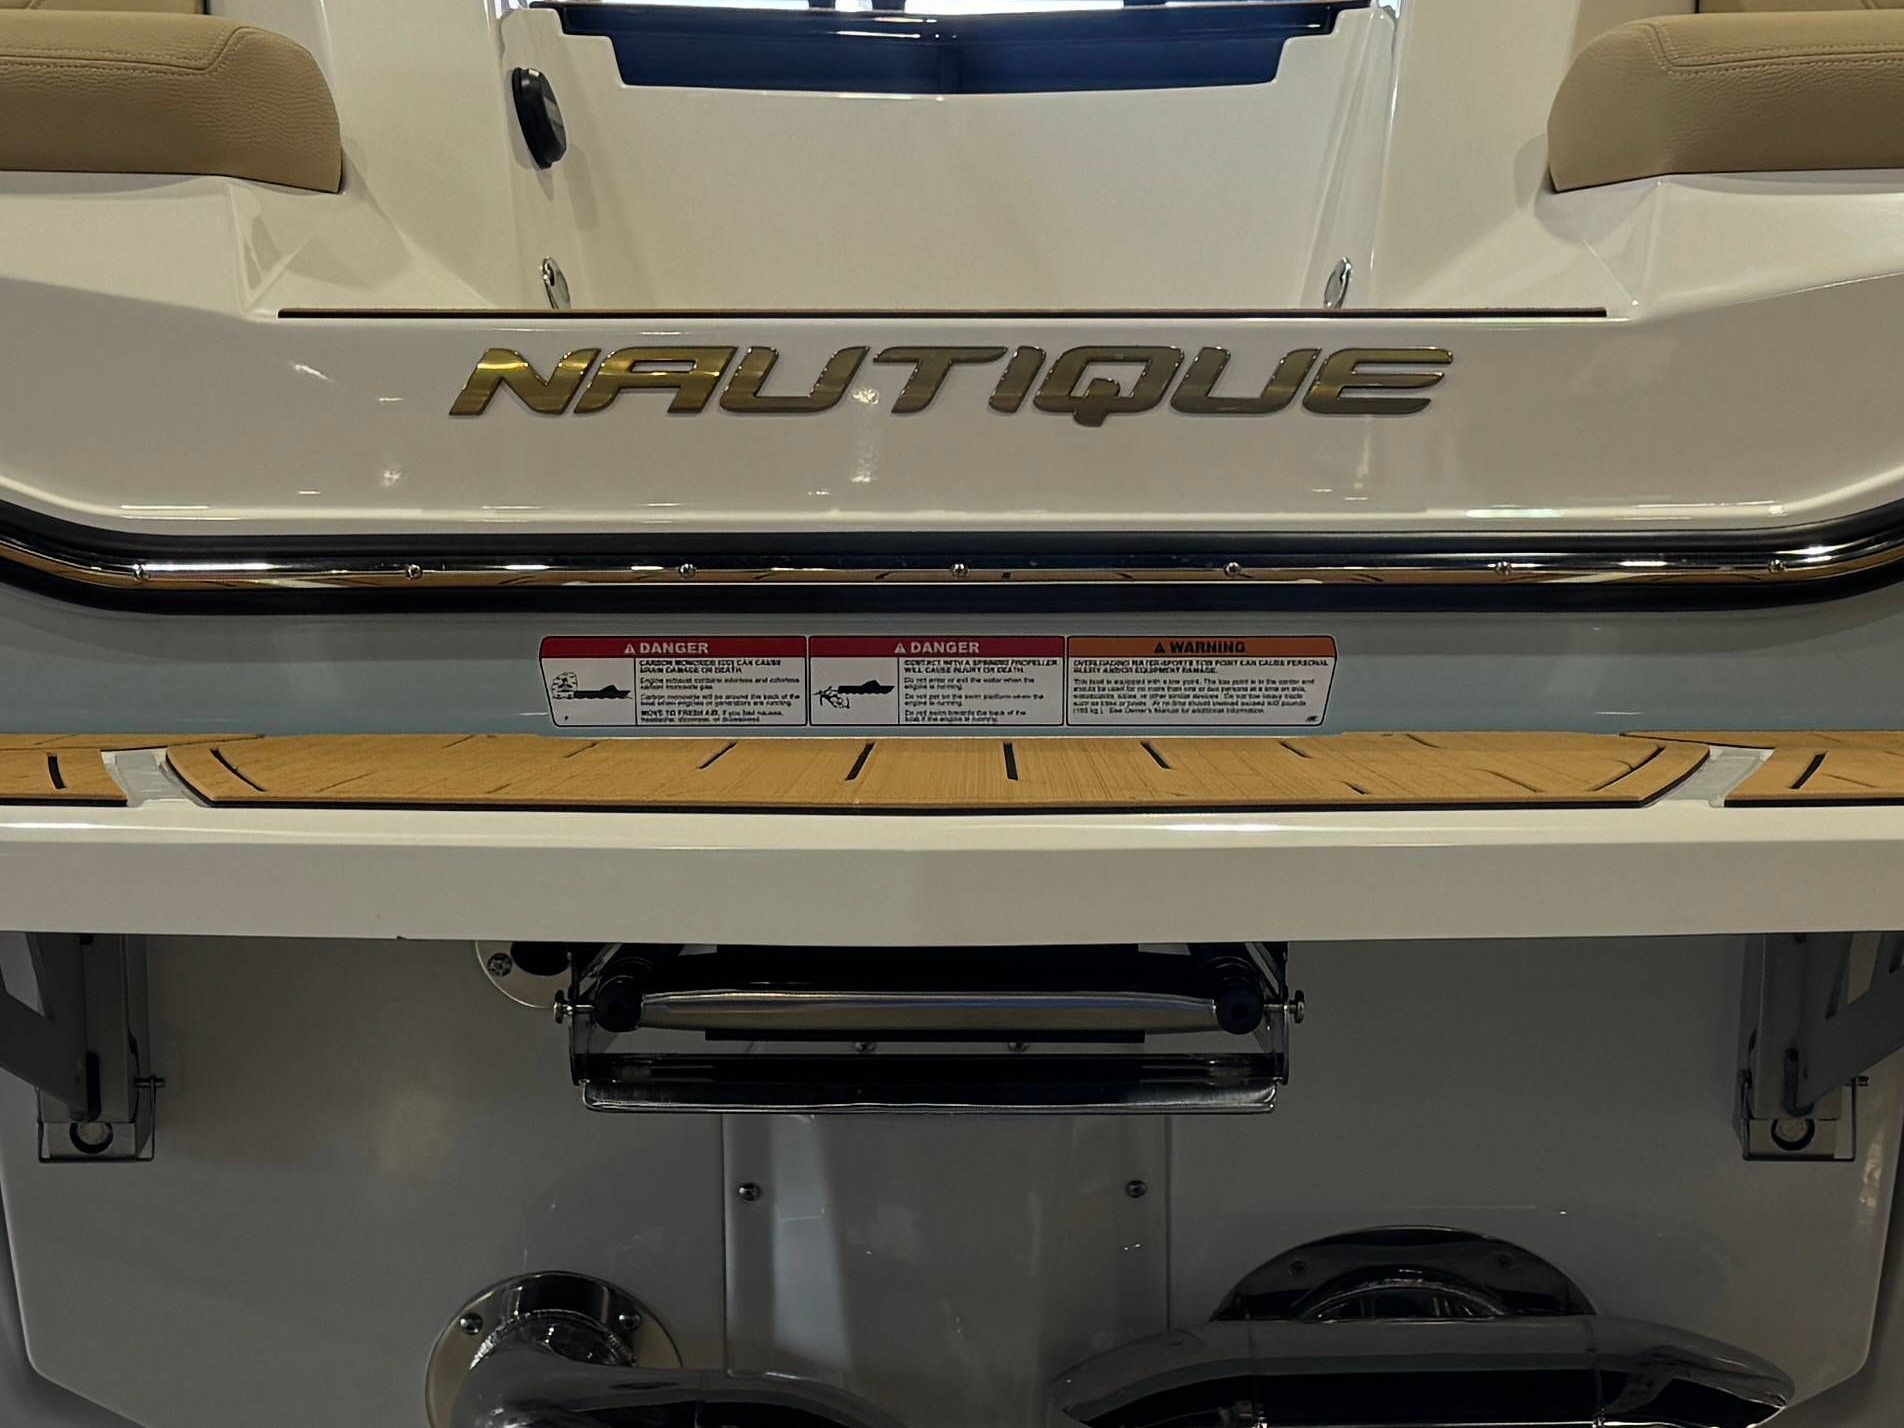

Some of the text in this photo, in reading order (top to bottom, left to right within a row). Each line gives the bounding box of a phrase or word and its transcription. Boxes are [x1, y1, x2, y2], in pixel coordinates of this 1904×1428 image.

[448, 344, 1456, 427] NAUTIQUE
[639, 642, 709, 654] DANGER
[910, 641, 980, 654] DANGER
[1169, 641, 1246, 654] WARNING
